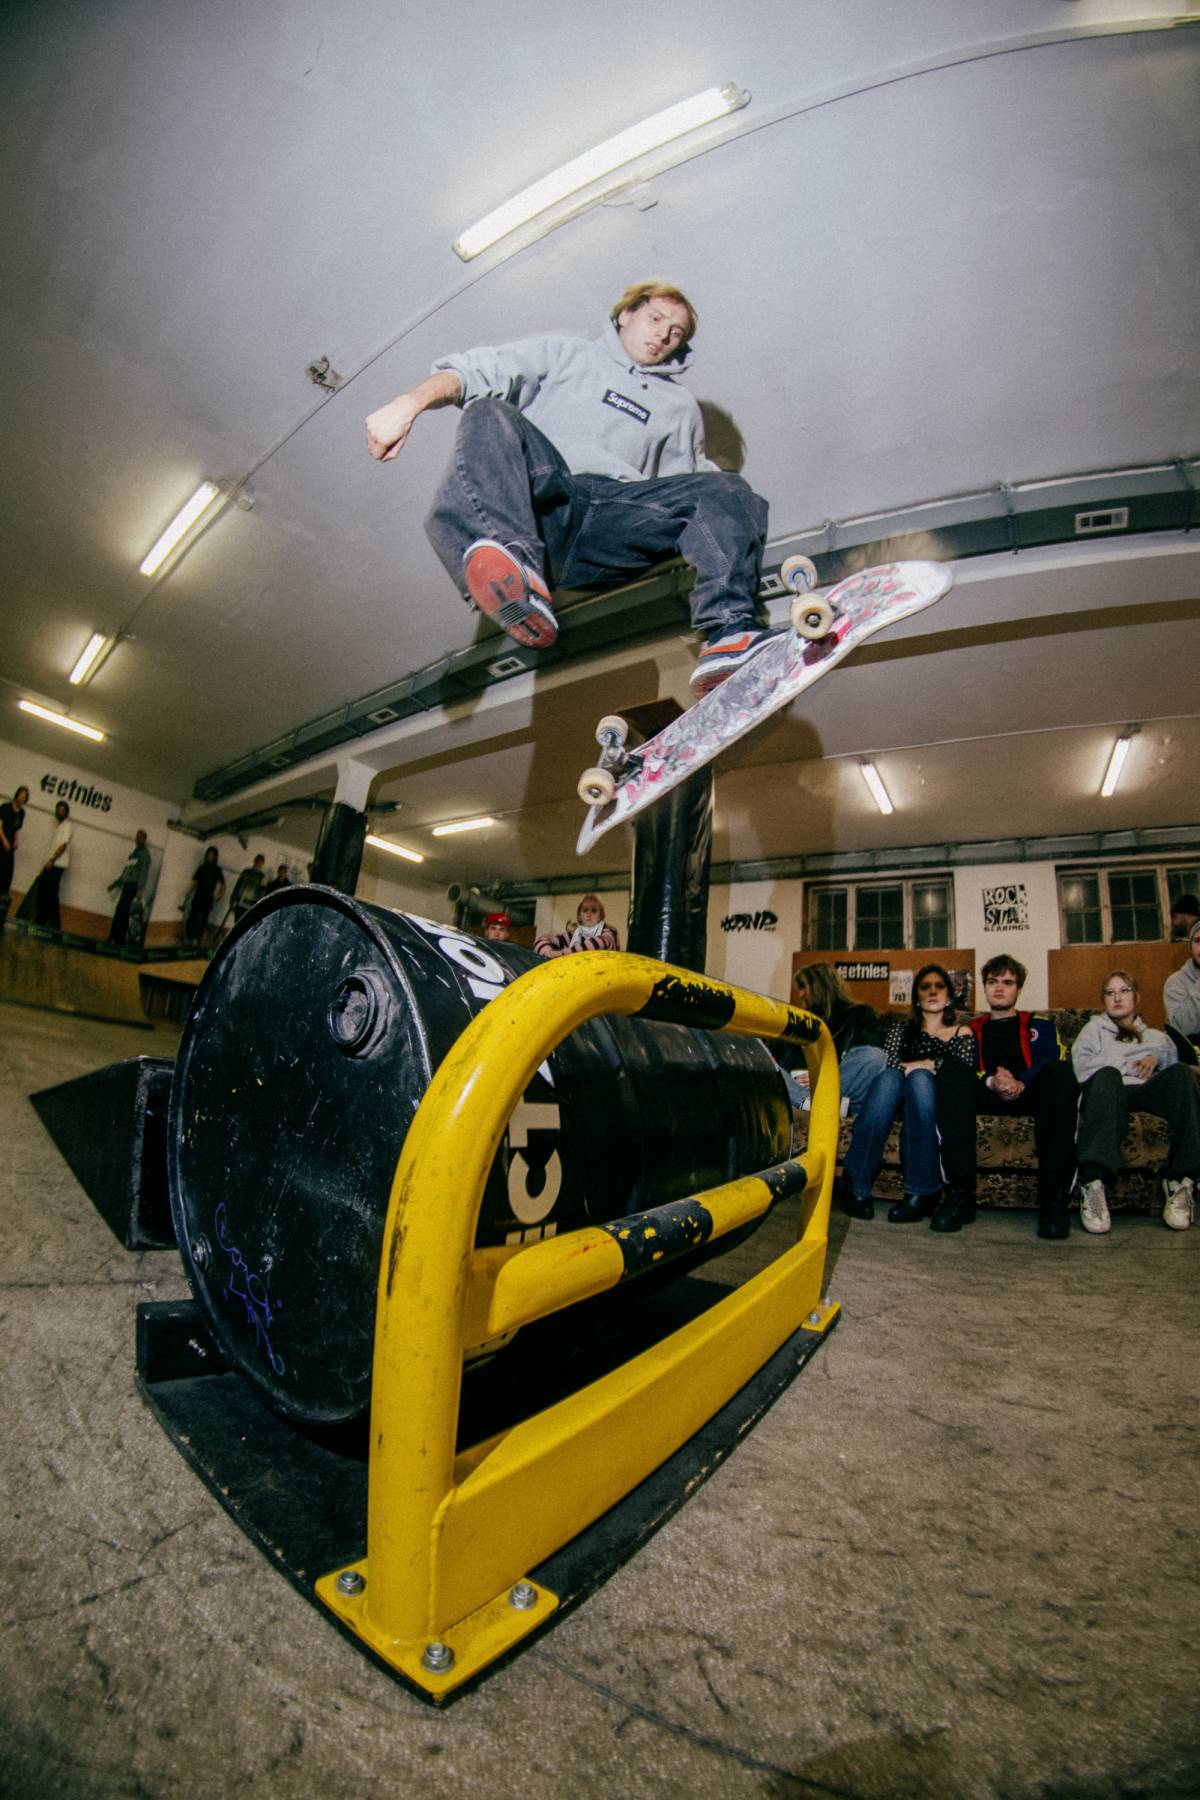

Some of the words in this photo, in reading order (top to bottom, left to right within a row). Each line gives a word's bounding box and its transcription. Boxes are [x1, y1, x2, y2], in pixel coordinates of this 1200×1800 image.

[607, 391, 648, 420] Supreme
[57, 779, 113, 813] etnies
[982, 885, 1028, 906] ROCK
[848, 963, 889, 979] etnies
